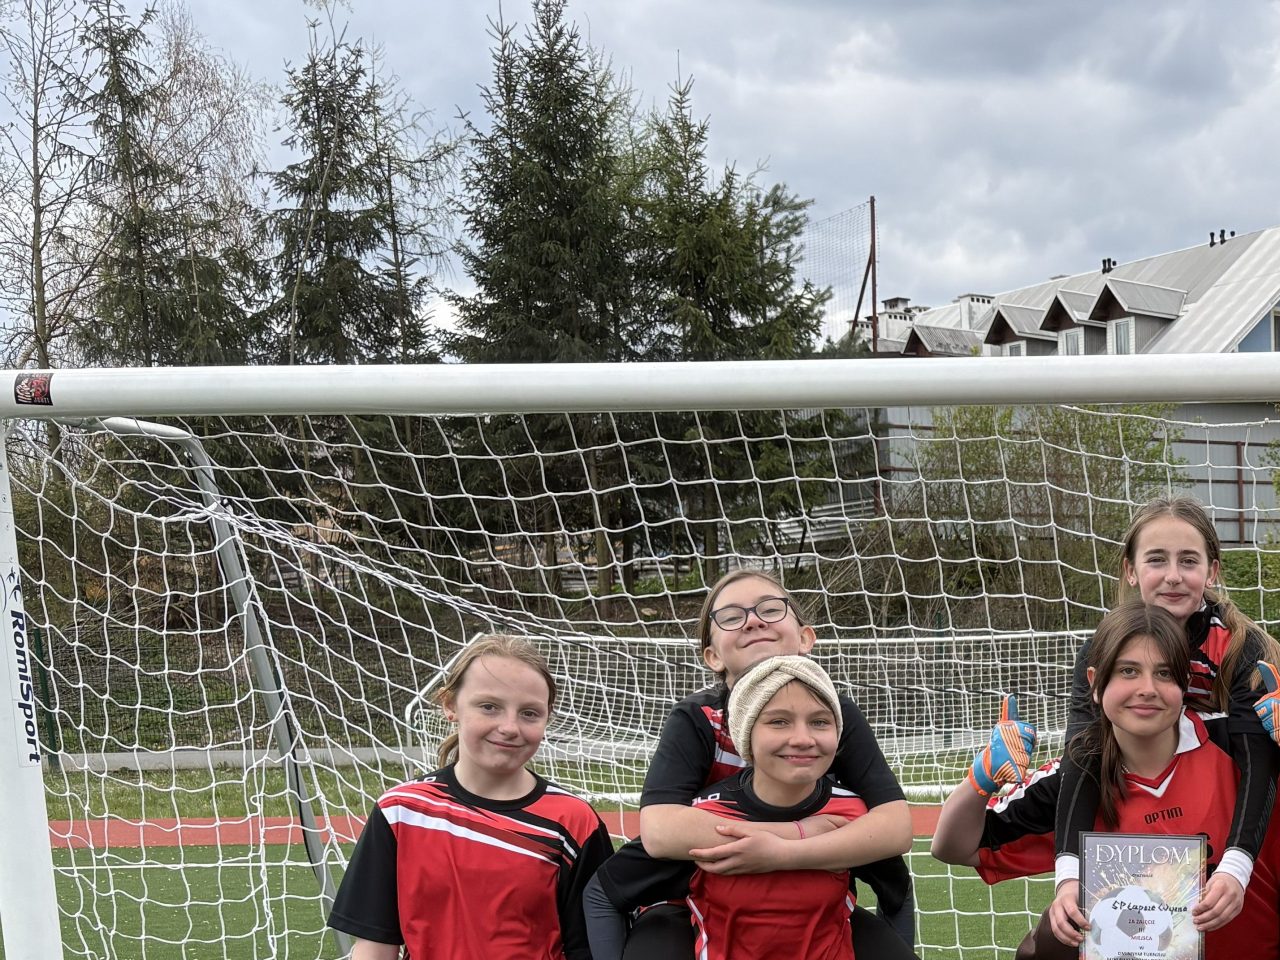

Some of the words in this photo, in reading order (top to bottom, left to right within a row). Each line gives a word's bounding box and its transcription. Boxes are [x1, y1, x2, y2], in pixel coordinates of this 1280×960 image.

[10, 610, 40, 764] RomiSport
[1144, 807, 1183, 825] OPTIM
[1096, 844, 1190, 865] DYPLOM
[1111, 900, 1127, 910] SP
